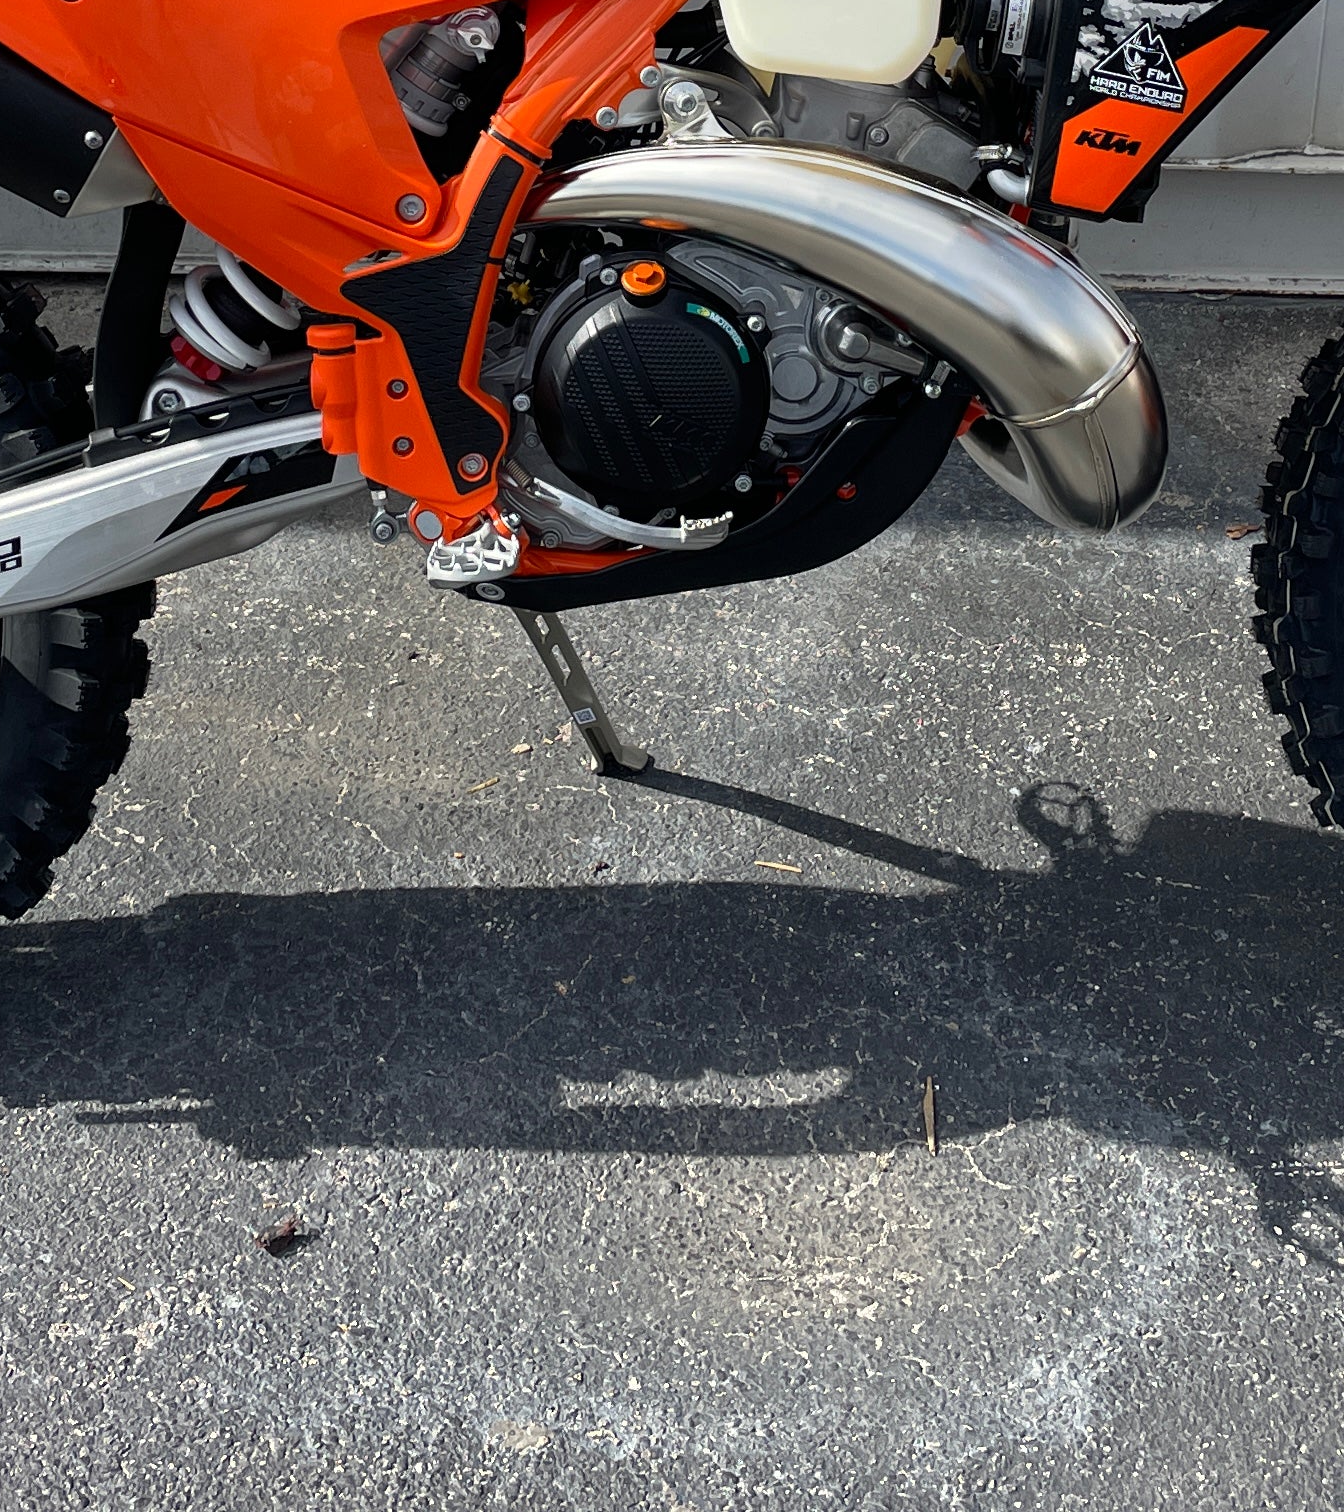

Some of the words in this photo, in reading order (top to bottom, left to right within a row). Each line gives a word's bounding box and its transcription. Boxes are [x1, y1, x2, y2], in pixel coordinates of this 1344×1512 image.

[1089, 75, 1128, 92] HARD
[1128, 83, 1184, 104] ENDURO
[1146, 67, 1171, 83] FIM
[1088, 84, 1119, 97] WORLD
[1118, 91, 1182, 109] CHAMPIONSHIP
[1073, 127, 1144, 157] KTM
[708, 311, 745, 351] MOTOREX
